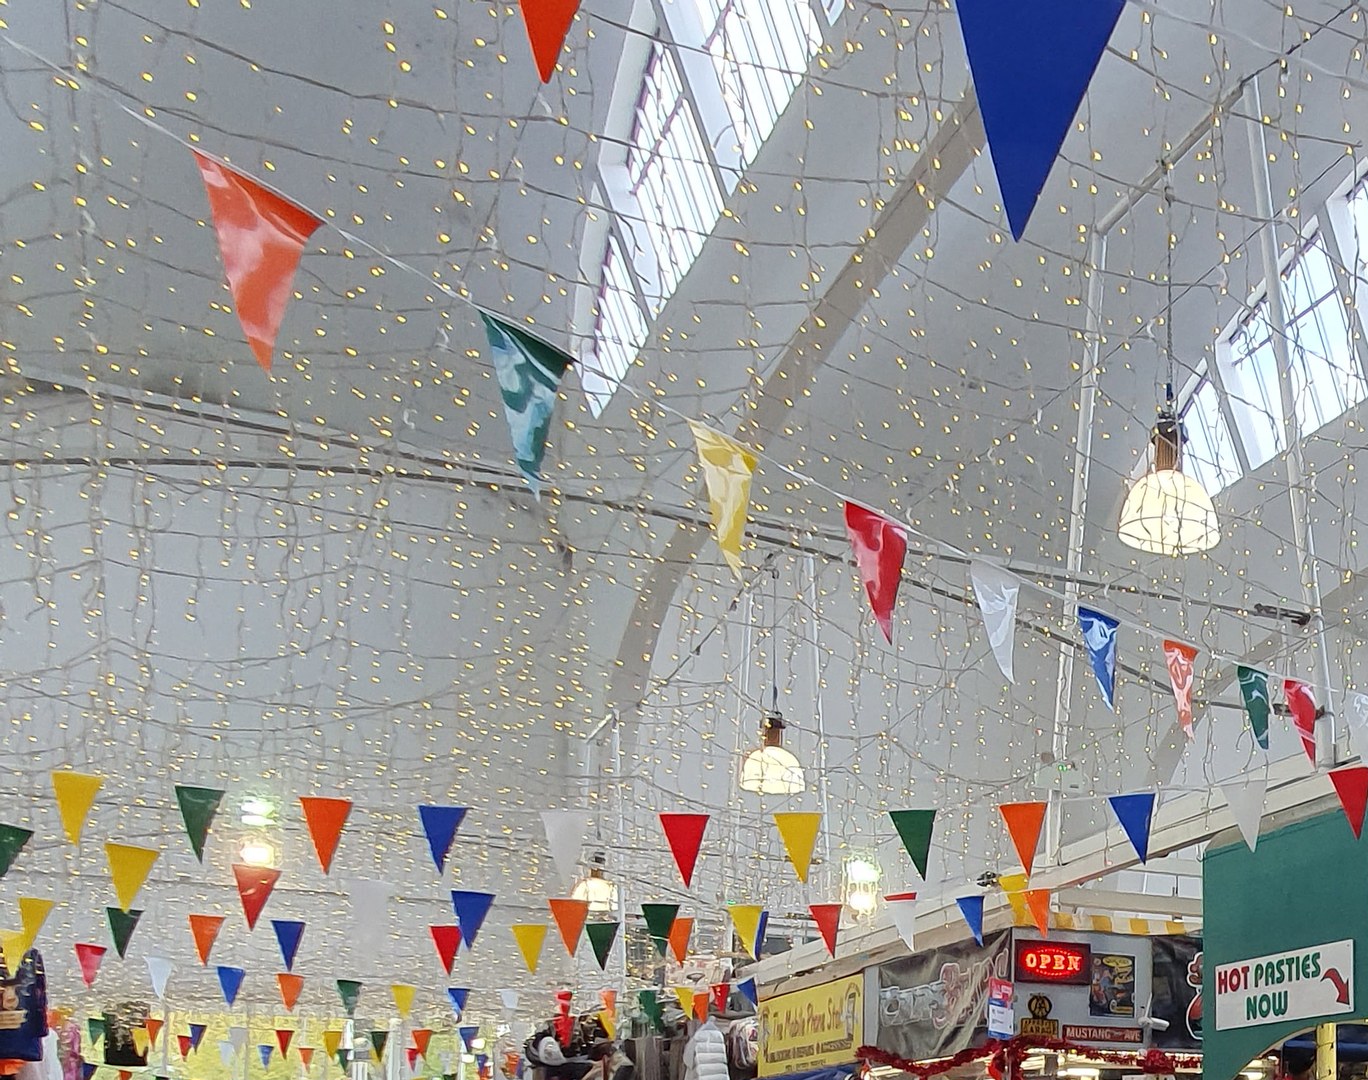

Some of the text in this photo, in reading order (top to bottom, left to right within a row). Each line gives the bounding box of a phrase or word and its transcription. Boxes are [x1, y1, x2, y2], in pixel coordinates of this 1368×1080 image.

[1025, 953, 1082, 971] OPEN
[1217, 952, 1321, 994] HOT PASTIES
[1246, 990, 1288, 1020] NOW
[1066, 1027, 1140, 1040] MUSTANG AVE
